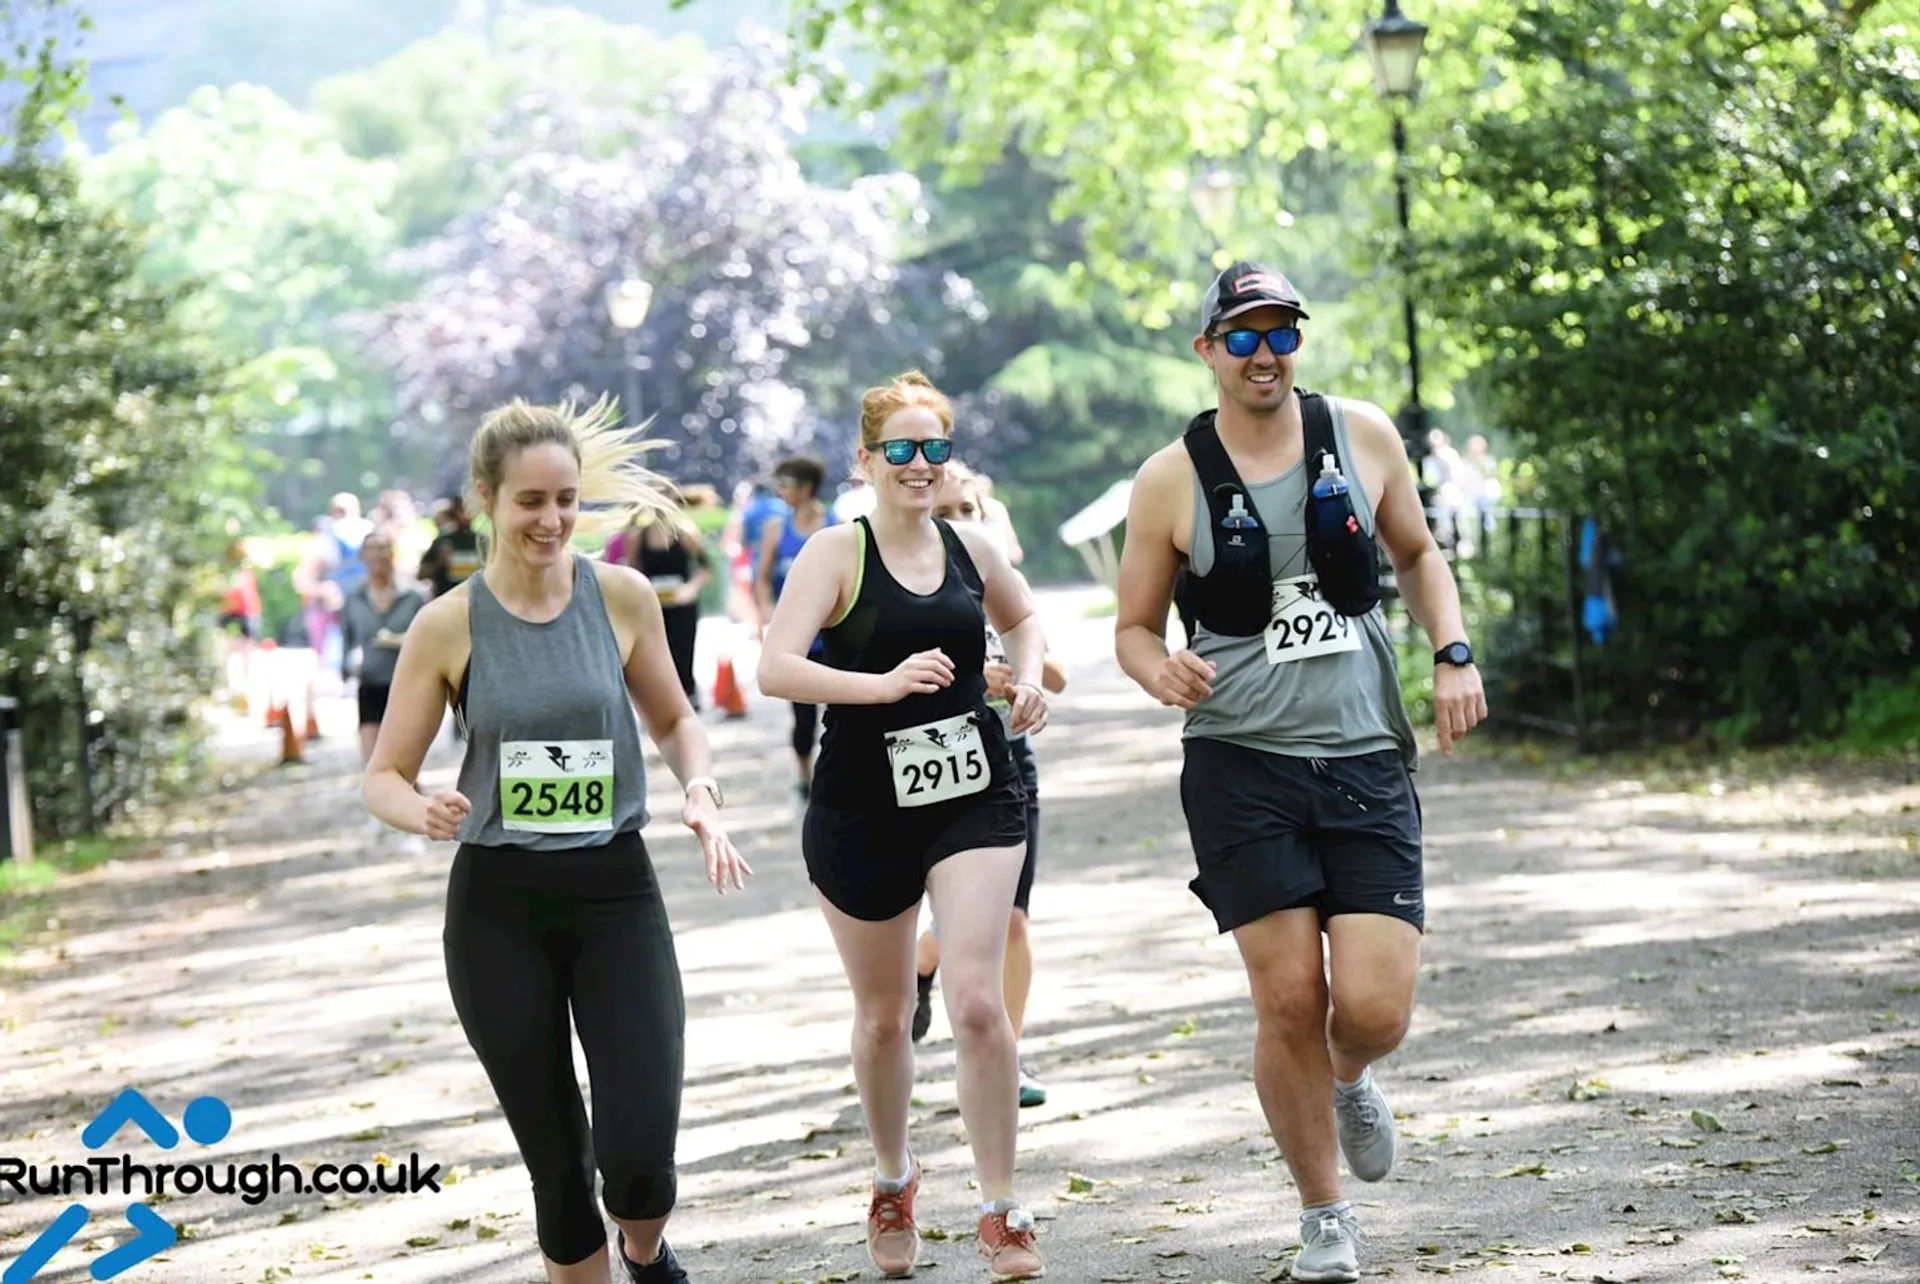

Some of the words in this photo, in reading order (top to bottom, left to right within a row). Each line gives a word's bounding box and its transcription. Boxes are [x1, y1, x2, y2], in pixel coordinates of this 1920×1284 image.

[1272, 610, 1348, 650] 2929
[902, 749, 982, 795] 2915
[511, 780, 604, 817] 2548
